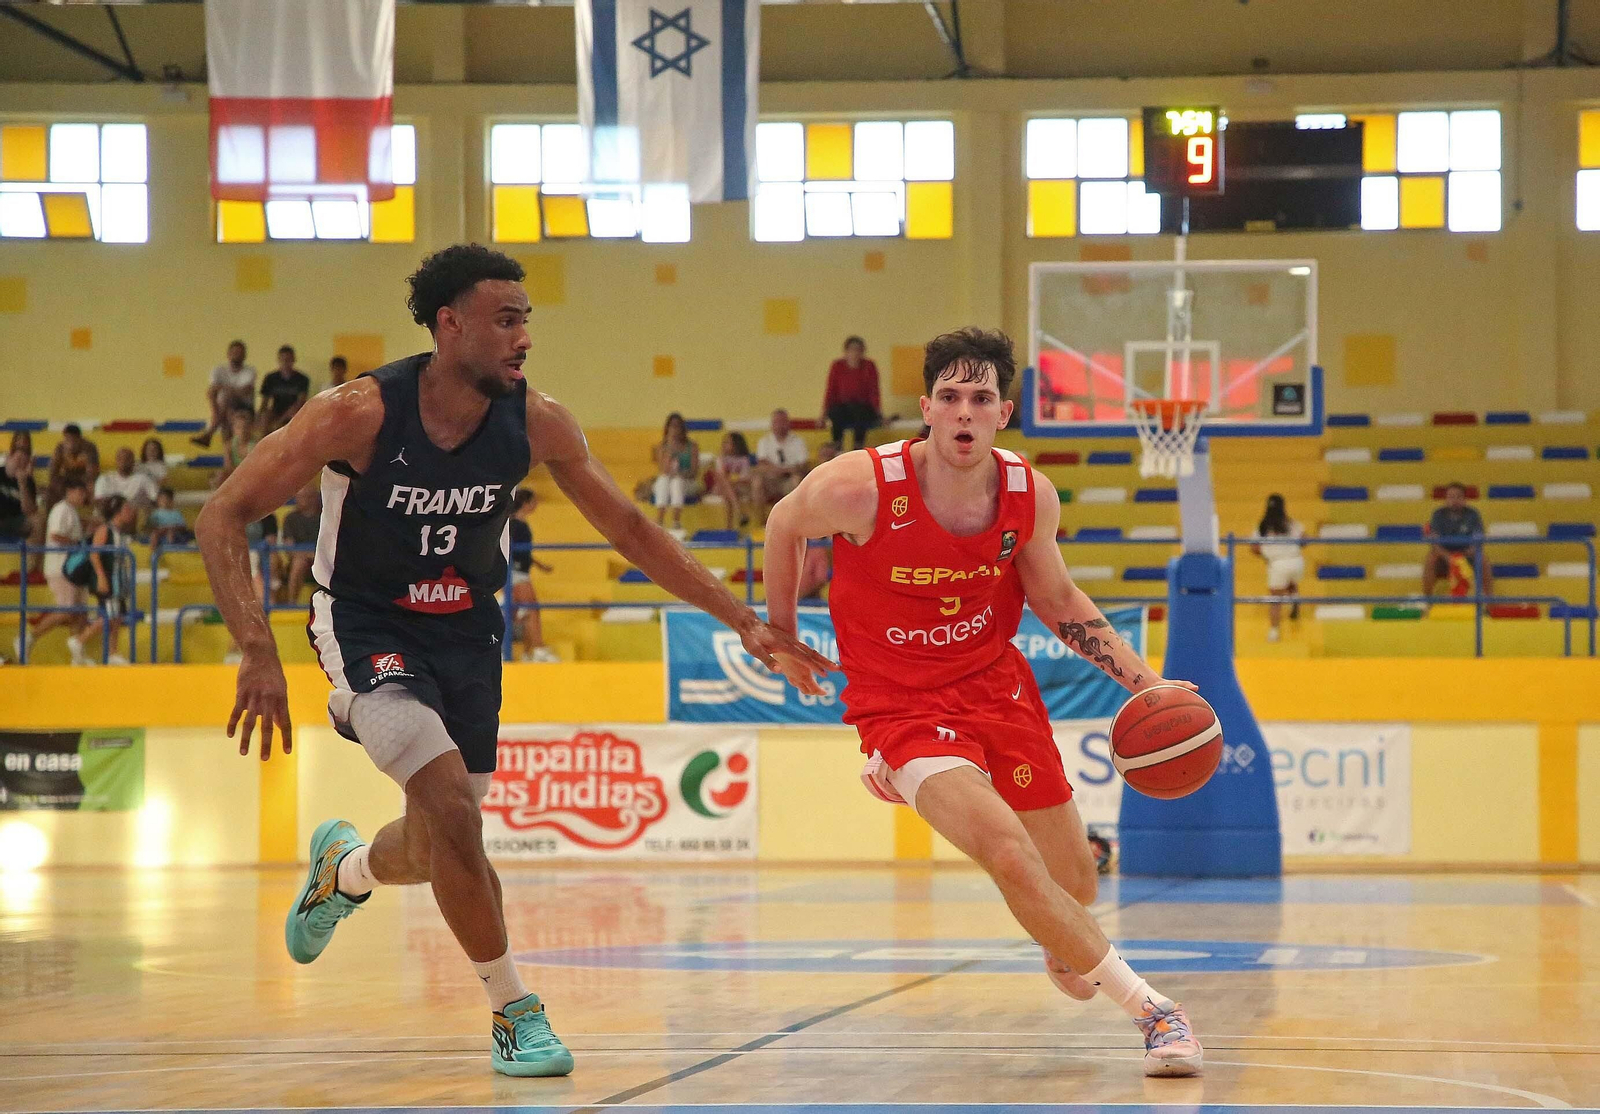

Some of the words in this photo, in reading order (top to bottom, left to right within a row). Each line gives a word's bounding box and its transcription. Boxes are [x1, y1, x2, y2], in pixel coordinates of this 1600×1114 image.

[1187, 136, 1213, 184] 9
[386, 484, 502, 515] FRANCE
[419, 524, 458, 556] 13
[408, 583, 470, 603] MAIF
[5, 753, 30, 771] en
[35, 753, 83, 772] casa
